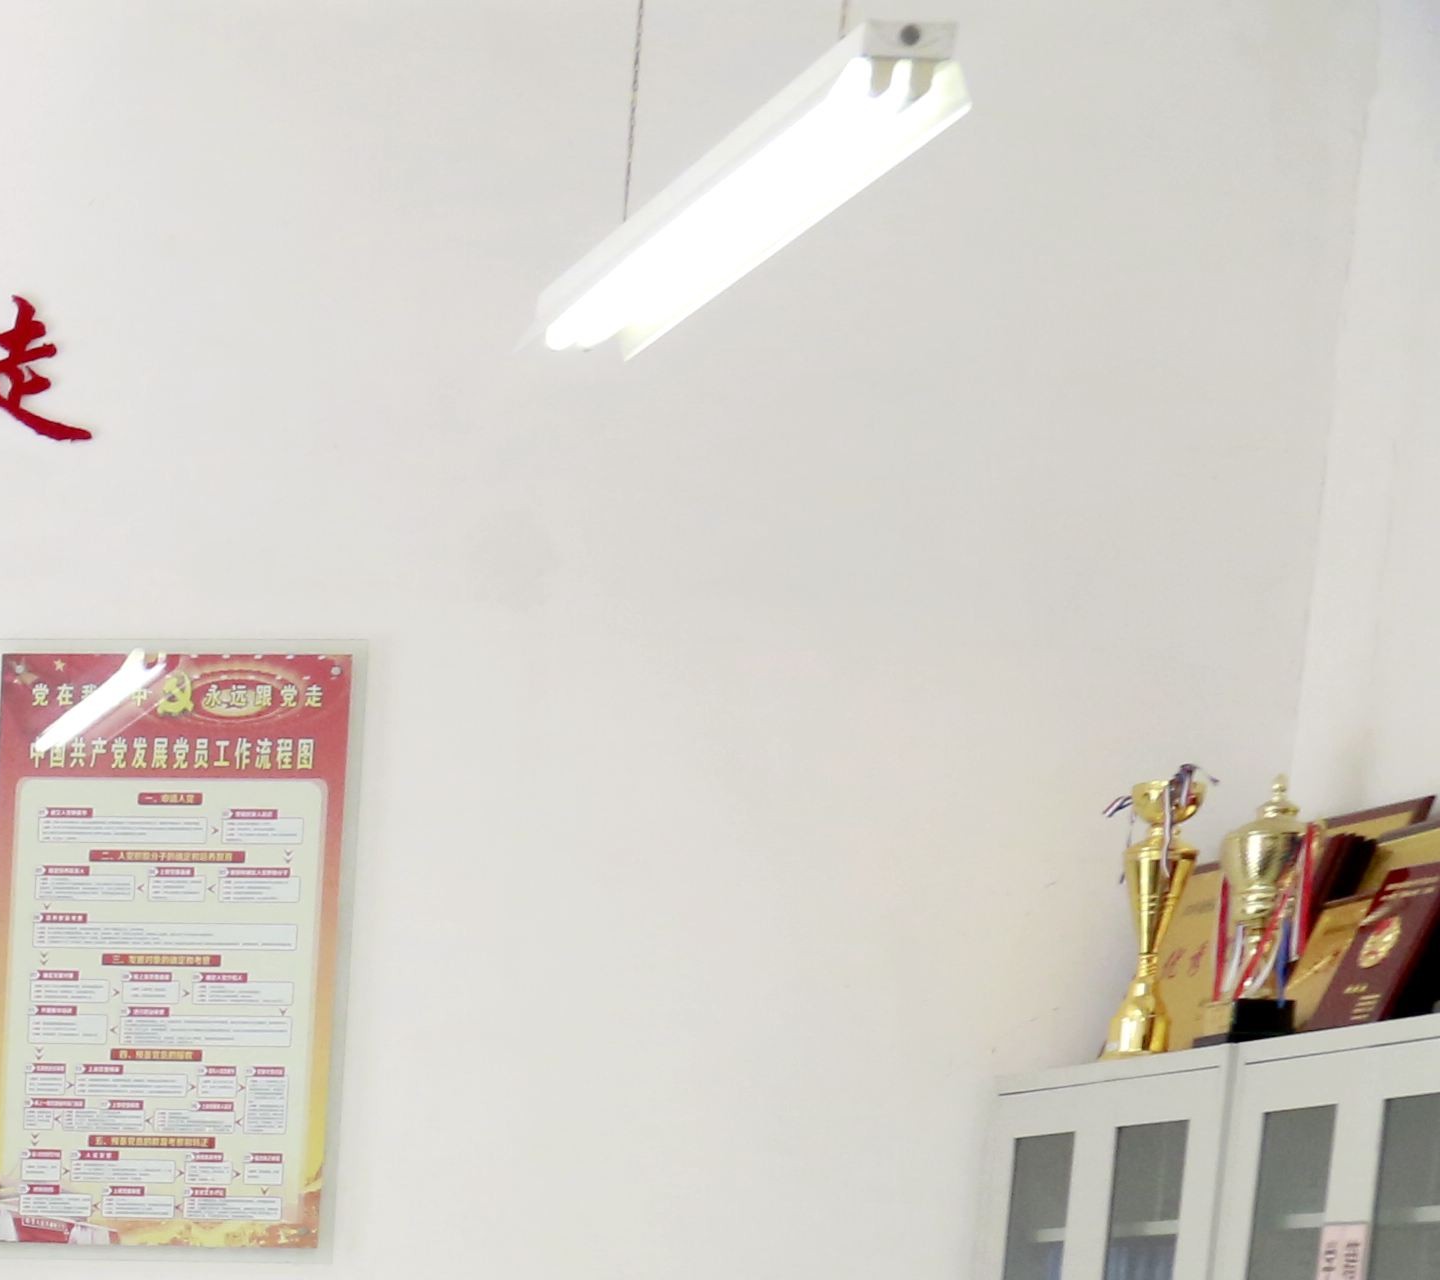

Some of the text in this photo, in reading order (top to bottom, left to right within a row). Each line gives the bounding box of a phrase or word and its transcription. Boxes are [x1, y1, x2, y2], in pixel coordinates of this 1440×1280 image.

[204, 683, 324, 709] 永远跟党走
[30, 736, 315, 771] 中国共产党发展党员工作流程图
